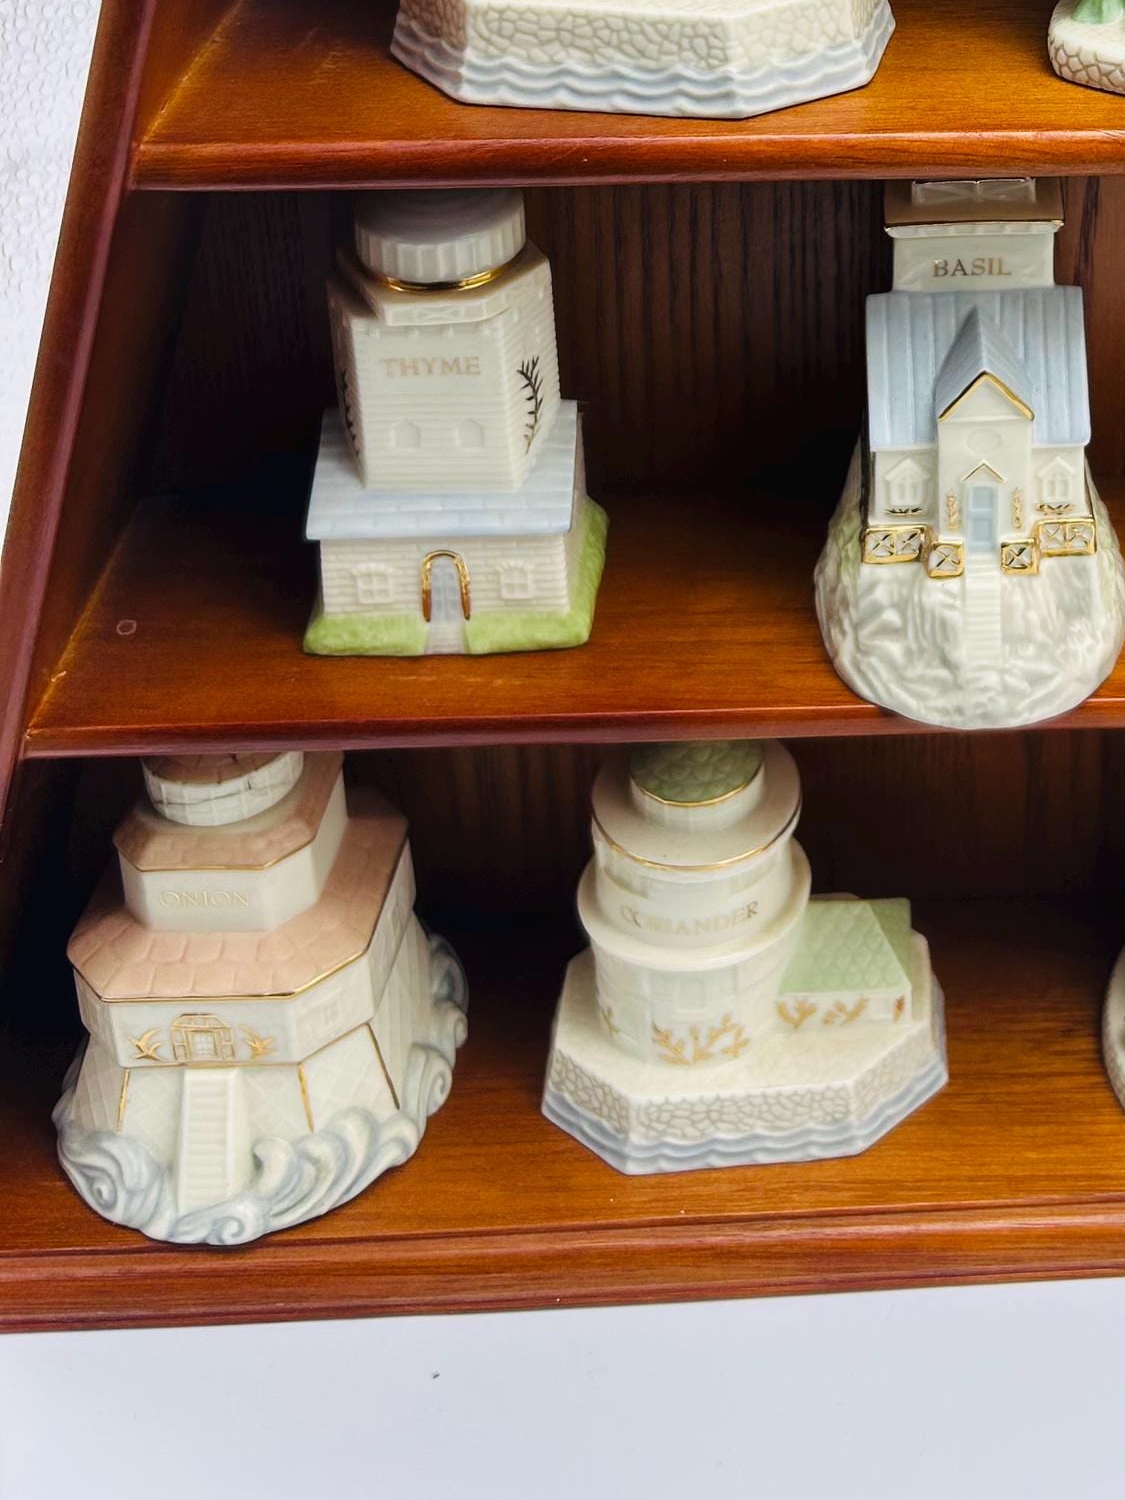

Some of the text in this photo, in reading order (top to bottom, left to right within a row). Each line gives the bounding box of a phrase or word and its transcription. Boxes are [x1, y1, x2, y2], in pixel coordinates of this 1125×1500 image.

[932, 258, 1012, 277] BASIL
[381, 356, 481, 377] THYME
[159, 890, 249, 908] ONION
